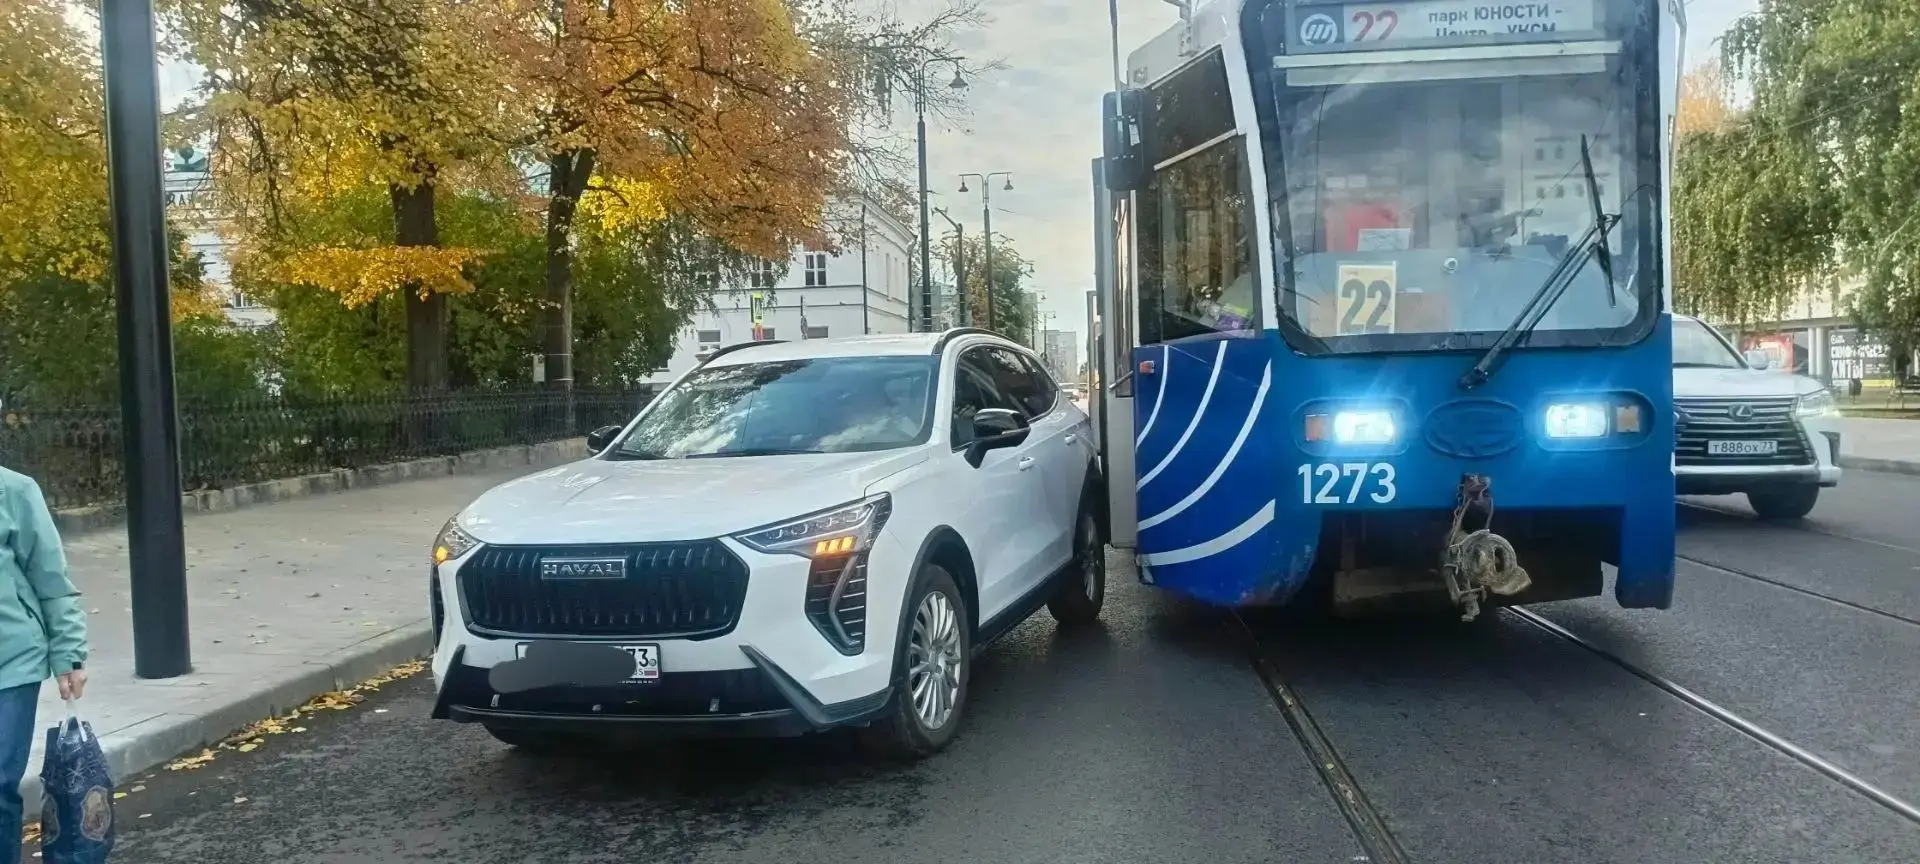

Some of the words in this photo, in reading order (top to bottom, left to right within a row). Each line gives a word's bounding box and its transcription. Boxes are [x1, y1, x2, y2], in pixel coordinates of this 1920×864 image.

[1352, 9, 1399, 42] 22
[1428, 11, 1468, 25] парк
[1474, 4, 1549, 20] ЮНОСТИ
[1341, 279, 1392, 333] 22
[1297, 463, 1396, 504] 1273
[543, 564, 620, 575] HAVAL
